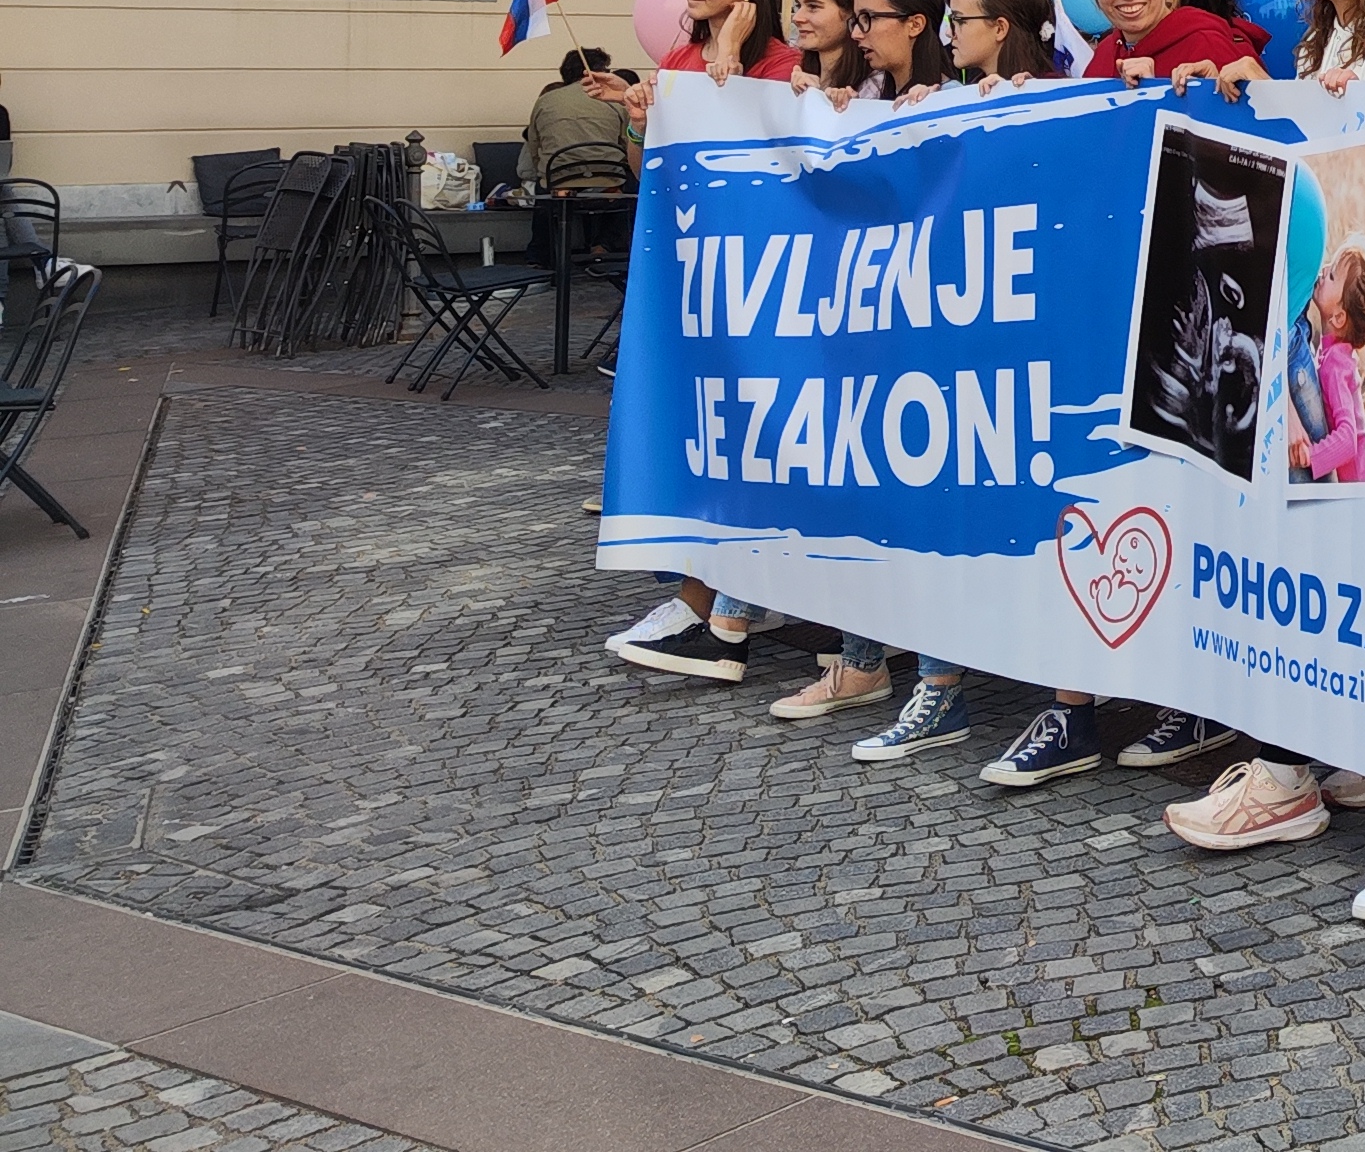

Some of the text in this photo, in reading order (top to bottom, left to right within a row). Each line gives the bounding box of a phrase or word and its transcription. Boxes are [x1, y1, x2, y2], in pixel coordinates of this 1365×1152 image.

[676, 204, 1037, 337] ŽIVLJENJE
[685, 361, 1054, 486] JE ZAKON!
[1193, 543, 1326, 635] POHOD
